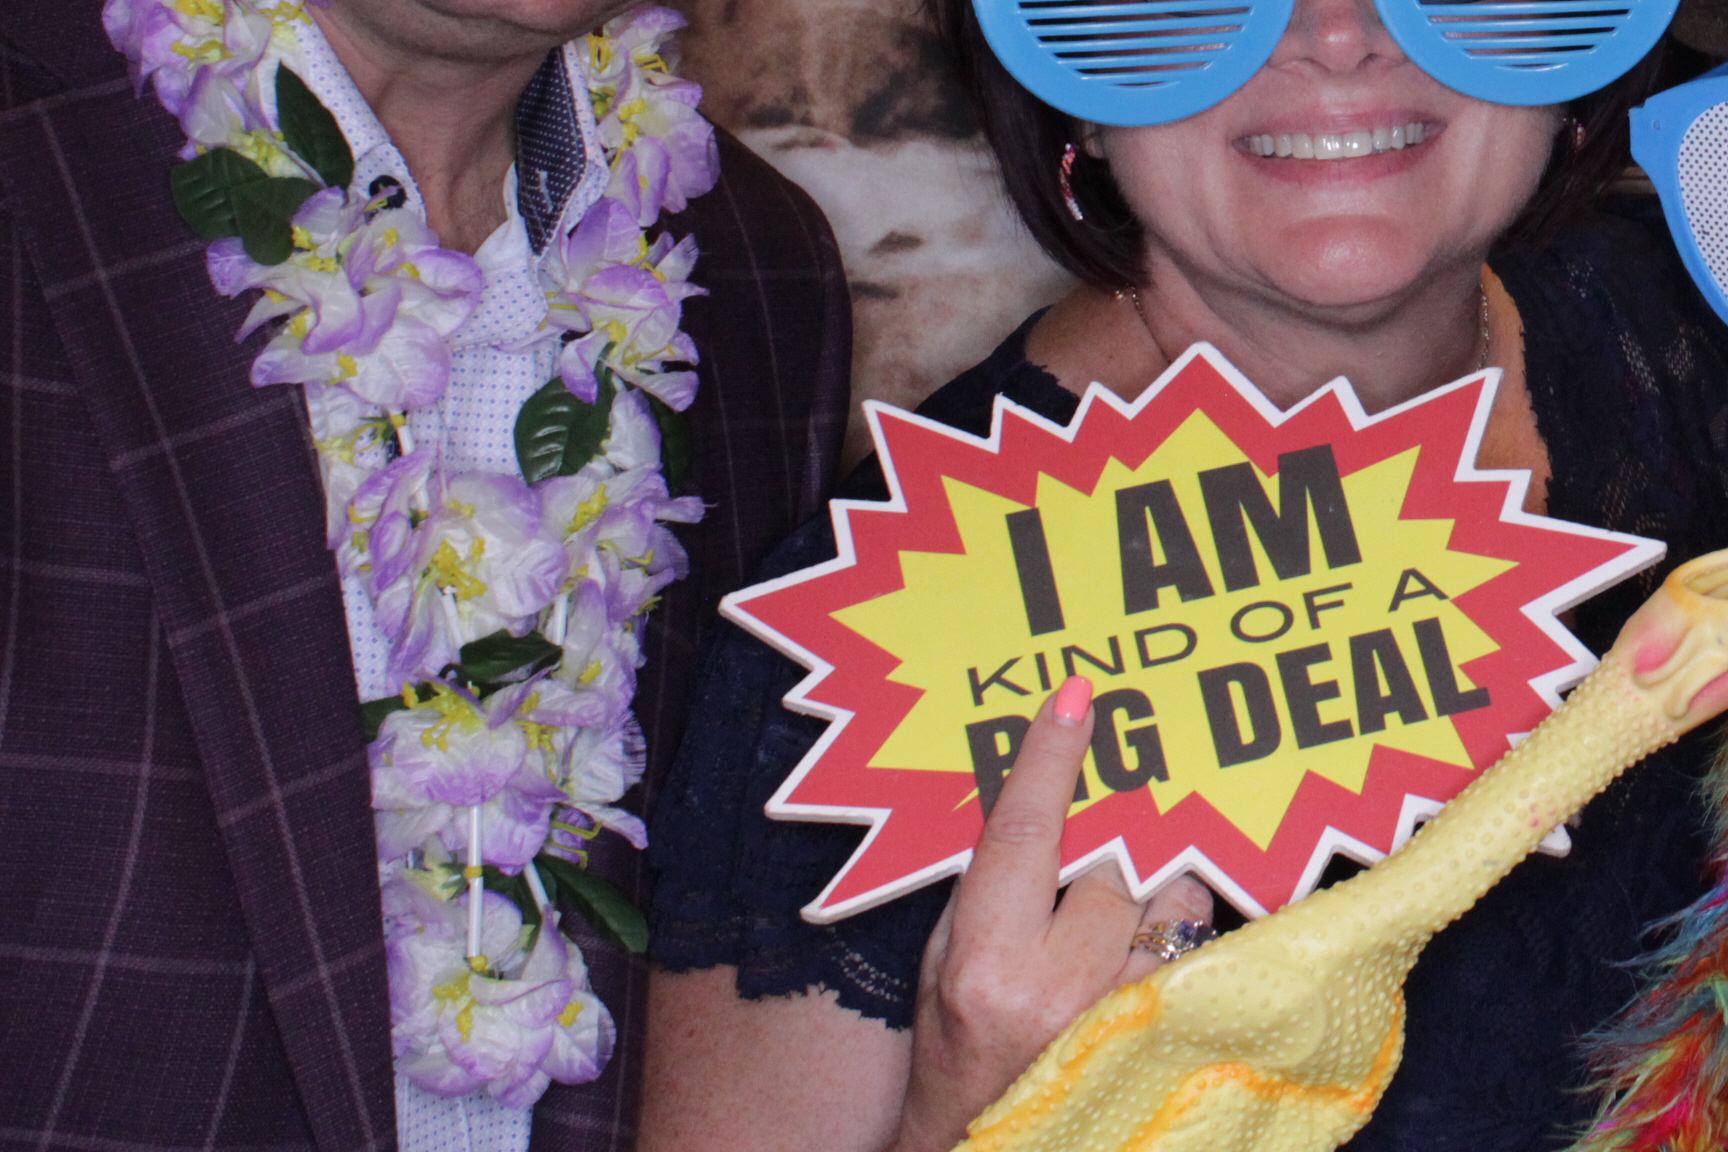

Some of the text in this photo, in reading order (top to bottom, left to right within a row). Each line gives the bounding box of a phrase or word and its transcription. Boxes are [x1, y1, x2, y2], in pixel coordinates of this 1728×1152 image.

[966, 566, 1450, 708] KIND OF A
[1006, 442, 1363, 637] I AM
[964, 616, 1493, 823] BG DEAL
